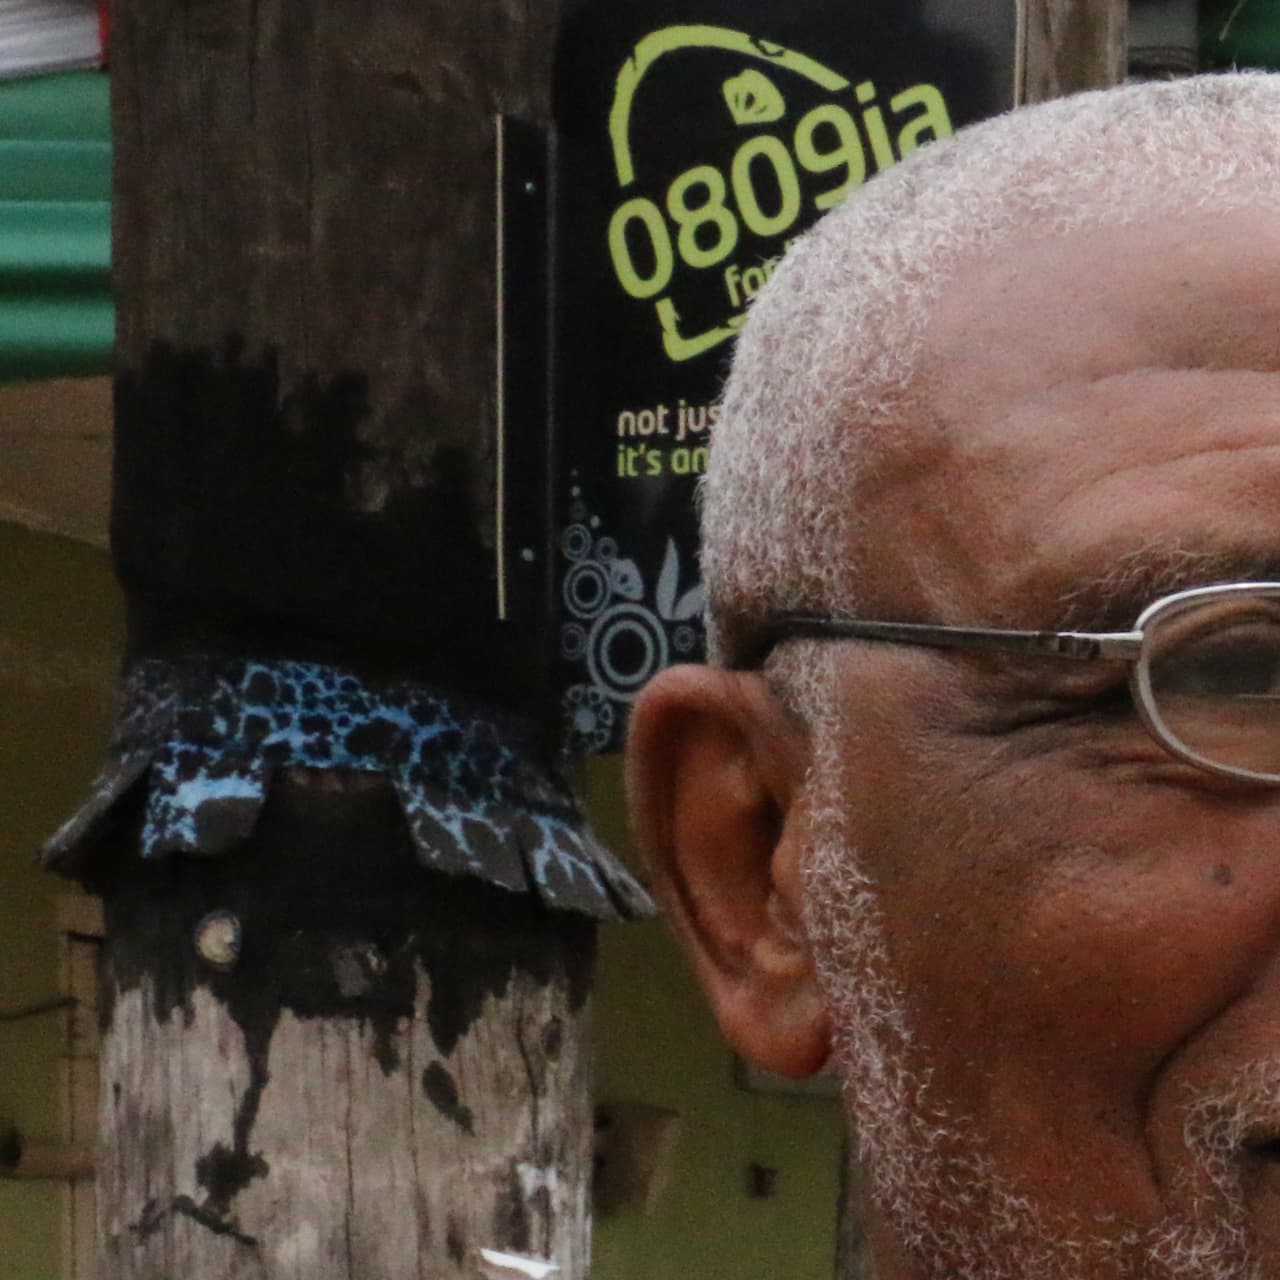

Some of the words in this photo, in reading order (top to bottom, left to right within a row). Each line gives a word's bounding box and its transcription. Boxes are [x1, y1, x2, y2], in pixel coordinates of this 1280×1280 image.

[617, 404, 669, 437] not
[675, 399, 721, 441] jus
[616, 444, 662, 477] it's
